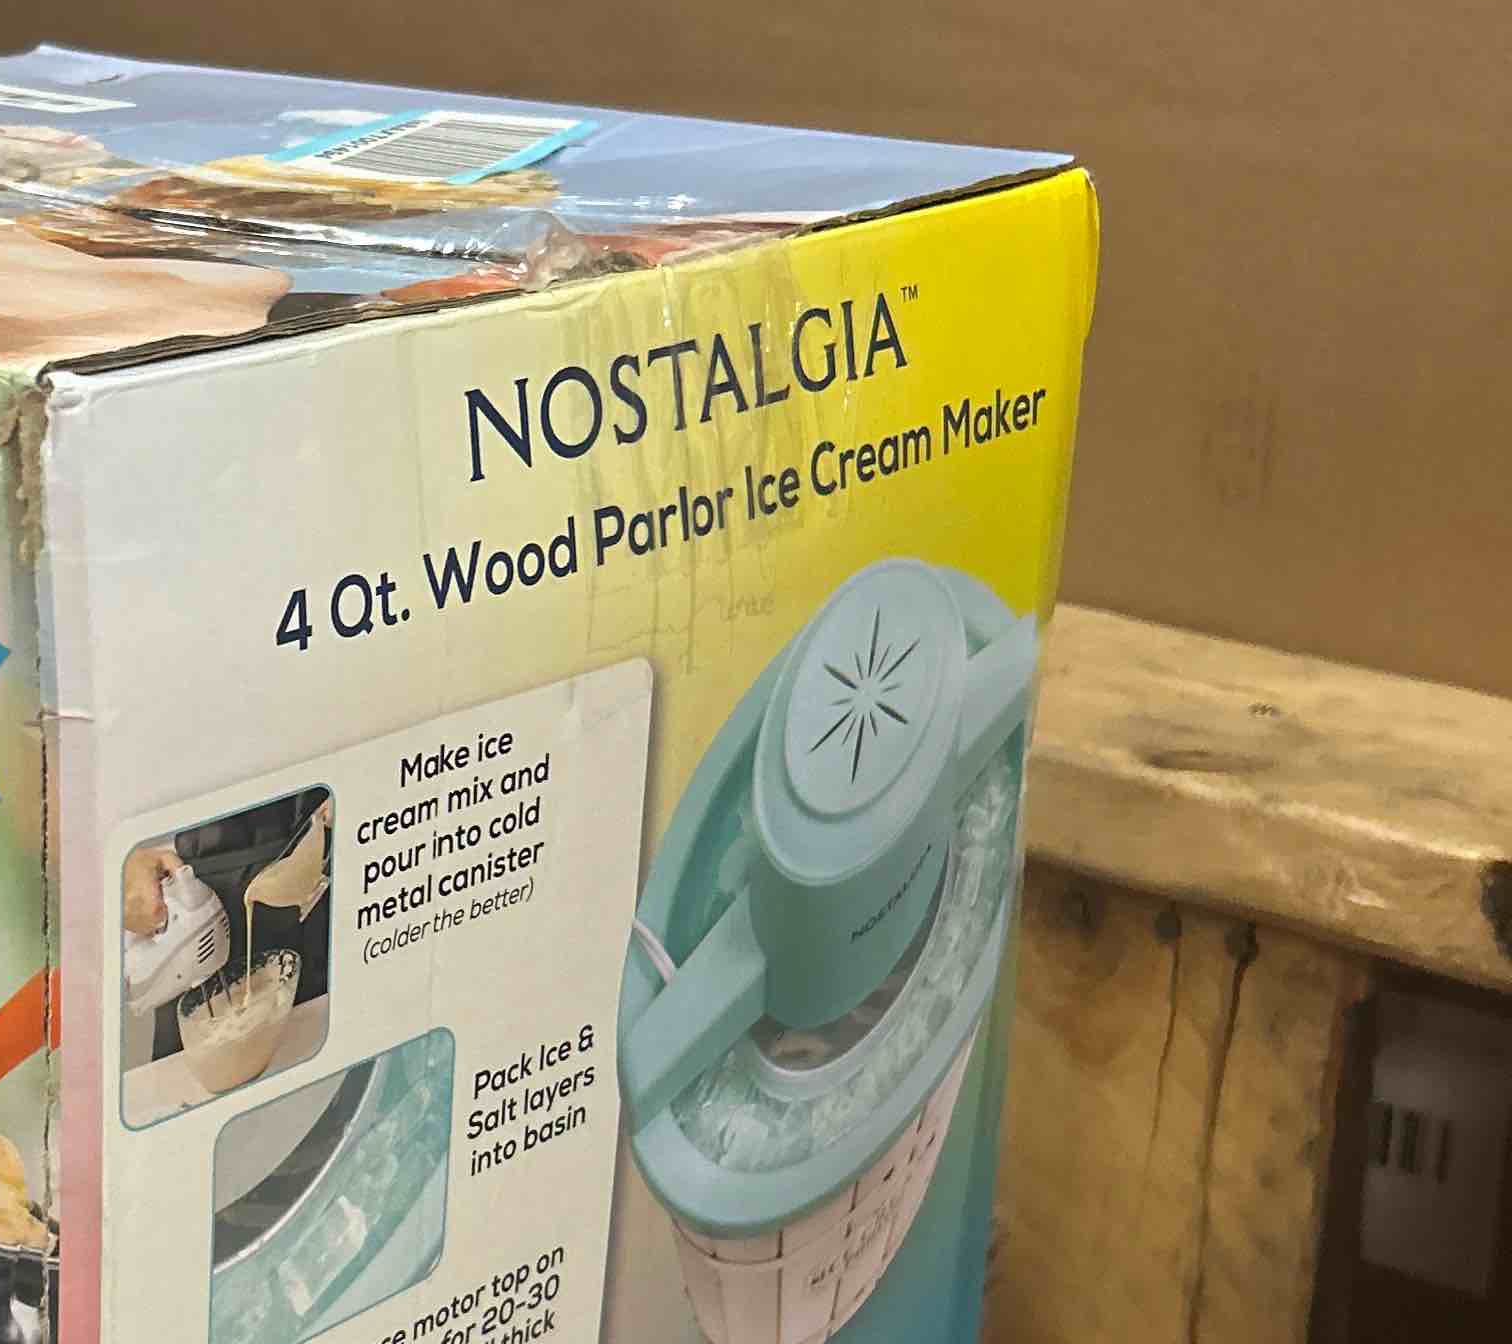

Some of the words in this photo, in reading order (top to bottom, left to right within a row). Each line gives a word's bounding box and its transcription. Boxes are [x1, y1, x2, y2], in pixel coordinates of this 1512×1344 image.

[274, 588, 313, 650] 4
[329, 573, 411, 640] Qt.
[424, 516, 578, 609] Wood
[595, 487, 735, 566] Parlor
[744, 464, 802, 517] Ice
[810, 425, 933, 496] Cream
[943, 390, 1048, 455] Maker
[357, 796, 438, 844] cream
[447, 776, 493, 813] mix
[500, 753, 550, 795] and
[400, 744, 470, 787] Make
[477, 732, 513, 762] ice
[357, 875, 432, 929] metal
[438, 841, 544, 897] canister
[363, 843, 426, 894] pour
[432, 824, 481, 860] into
[489, 796, 540, 839] cold
[362, 920, 430, 964] (colder
[433, 908, 464, 934] the
[470, 876, 534, 920] better)
[467, 1097, 517, 1139] Salt
[523, 1066, 595, 1115] layers
[474, 1053, 532, 1100] Pack
[539, 1041, 571, 1071] Ice
[471, 1139, 517, 1176] into
[523, 1106, 586, 1151] basin
[412, 1285, 486, 1341] motor
[491, 1263, 529, 1299] top
[536, 1246, 564, 1274] on
[481, 1274, 560, 1336] 20-30
